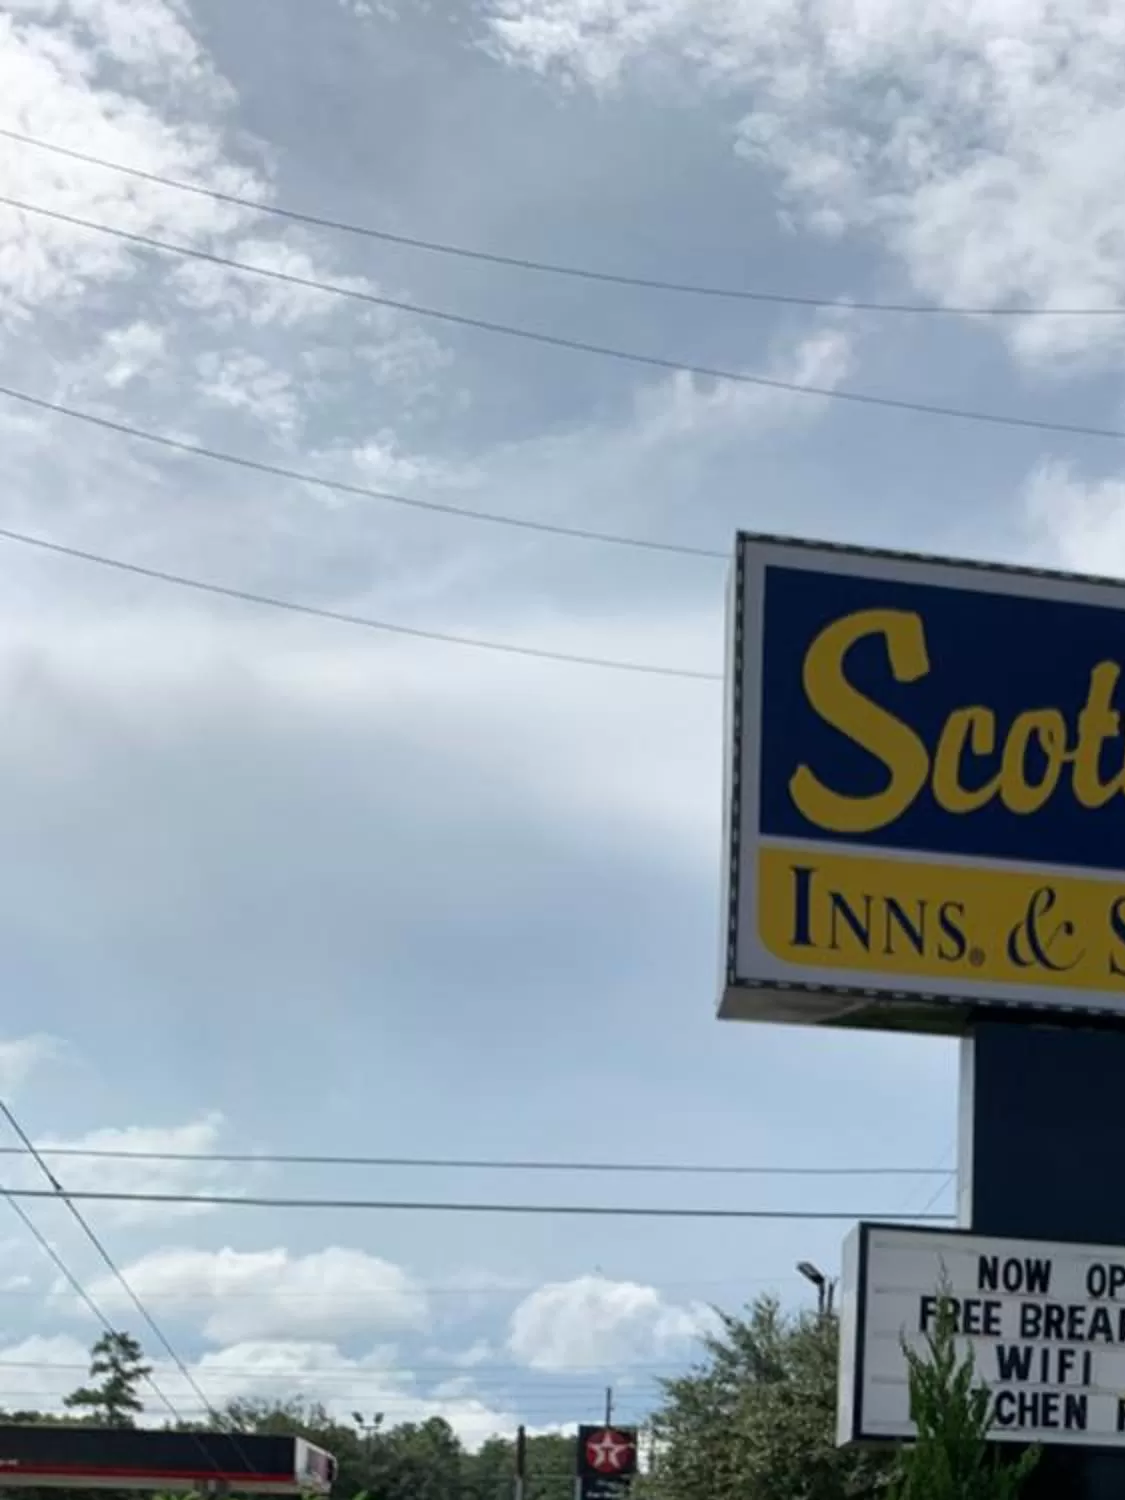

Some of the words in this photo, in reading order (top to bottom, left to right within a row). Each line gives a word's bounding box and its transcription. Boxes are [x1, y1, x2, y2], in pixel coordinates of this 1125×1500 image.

[1008, 886, 1086, 972] &
[977, 1255, 1052, 1293] NOW
[996, 1344, 1092, 1386] WIFI
